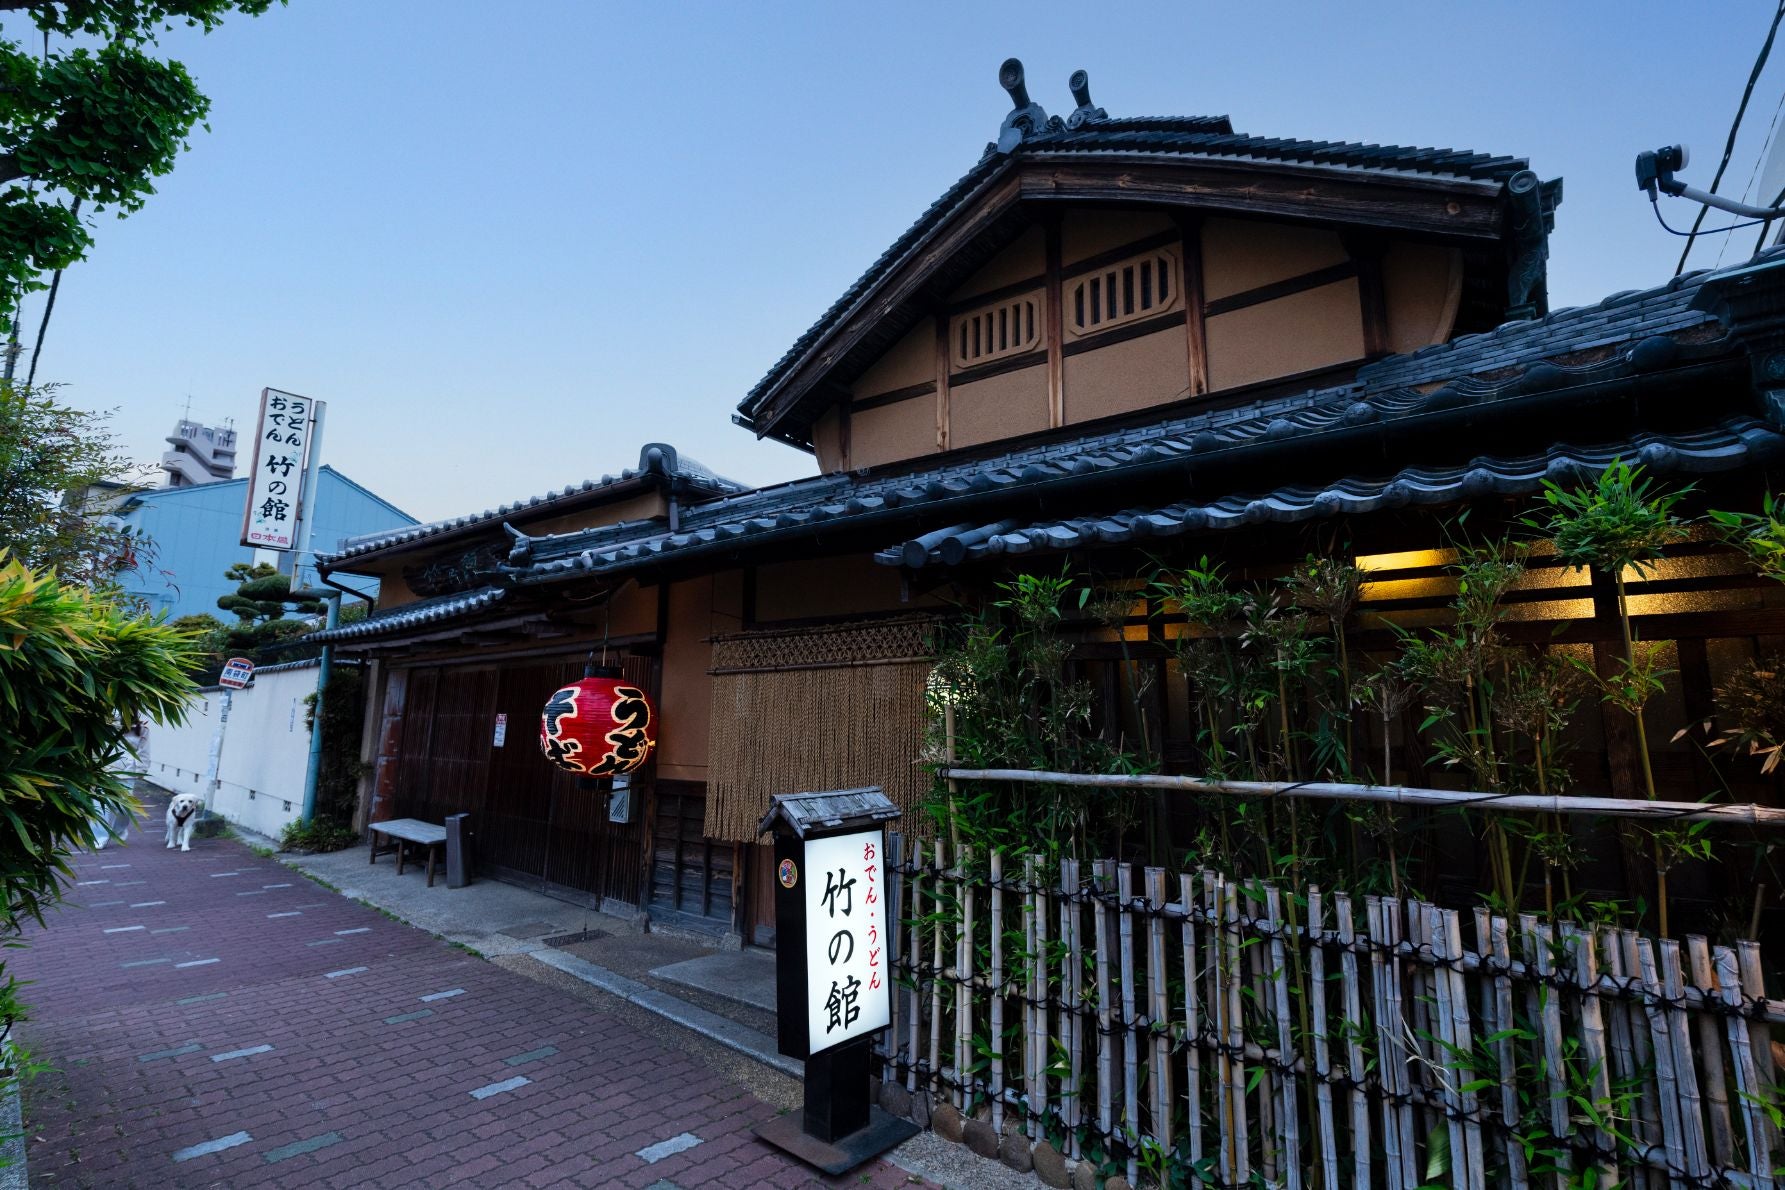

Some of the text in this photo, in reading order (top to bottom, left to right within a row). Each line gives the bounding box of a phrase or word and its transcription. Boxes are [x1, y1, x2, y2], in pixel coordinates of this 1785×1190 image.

[265, 396, 287, 443] おでん
[284, 401, 305, 447] うどん
[260, 453, 295, 522] 竹の館
[821, 867, 862, 1035] 竹の館
[863, 842, 882, 991] おでん・うどん
